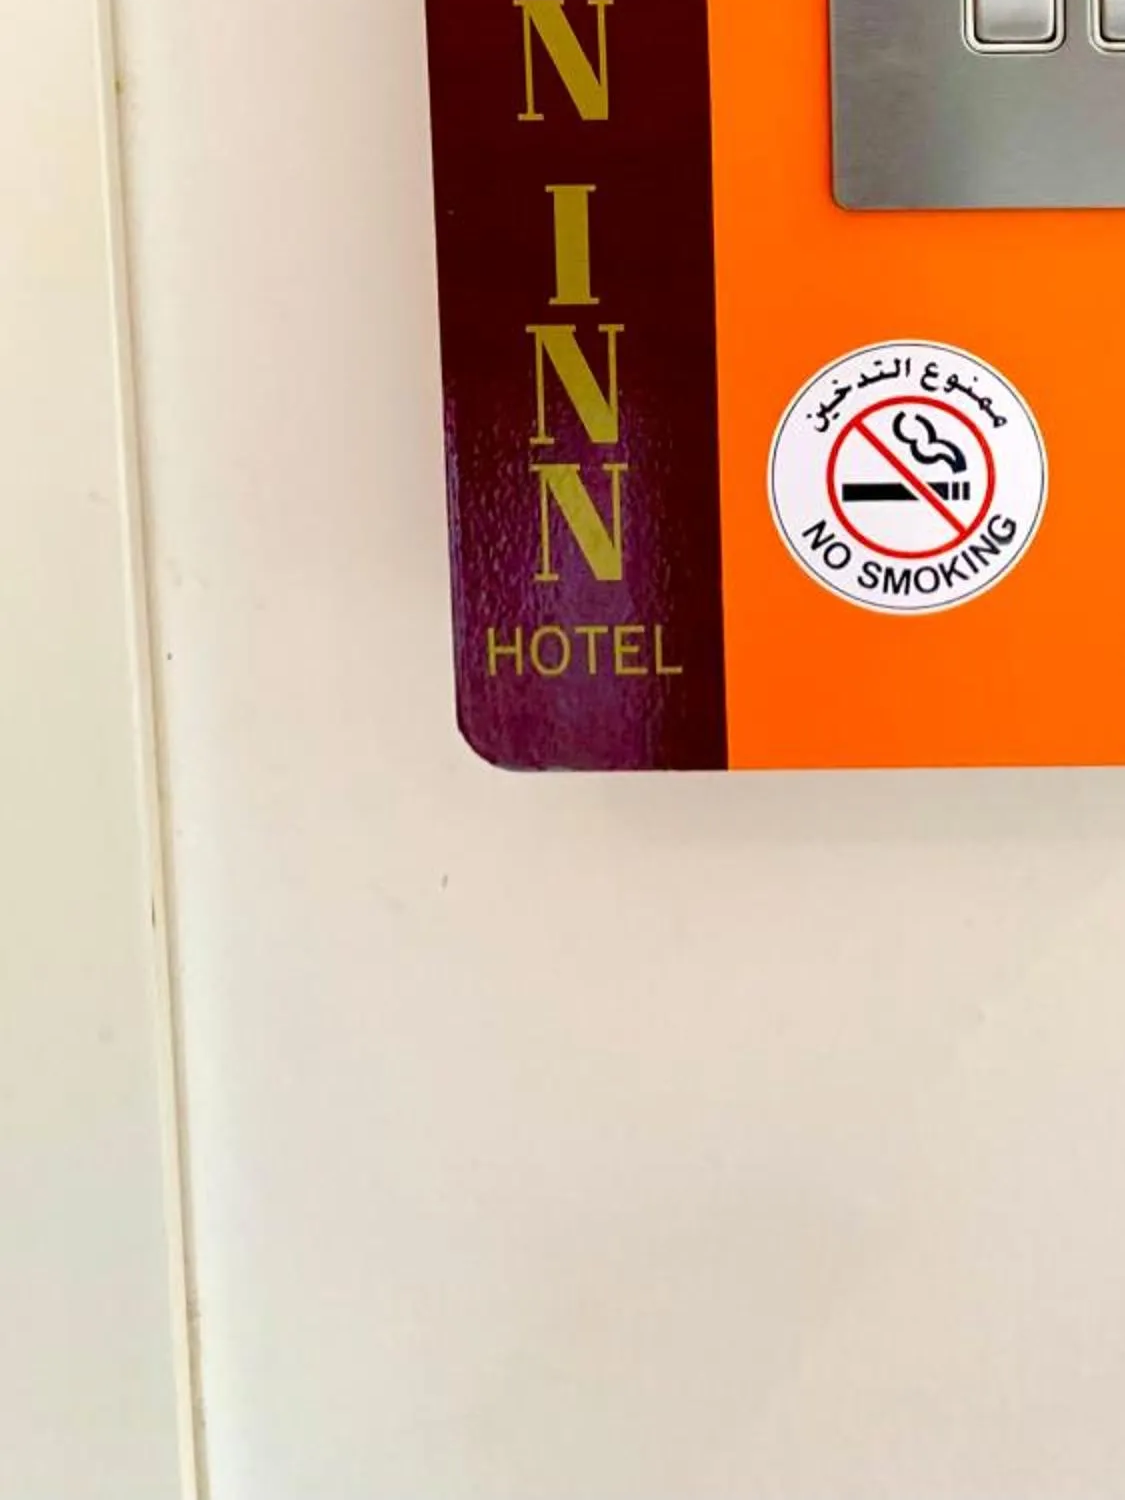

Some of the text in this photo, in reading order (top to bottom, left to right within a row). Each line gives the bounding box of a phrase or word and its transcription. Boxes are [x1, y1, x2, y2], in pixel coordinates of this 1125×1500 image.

[526, 184, 629, 581] INN
[806, 357, 1007, 433] ممنوع التدخين
[802, 513, 1017, 596] NO SMOKING
[488, 625, 683, 676] HOTEL
